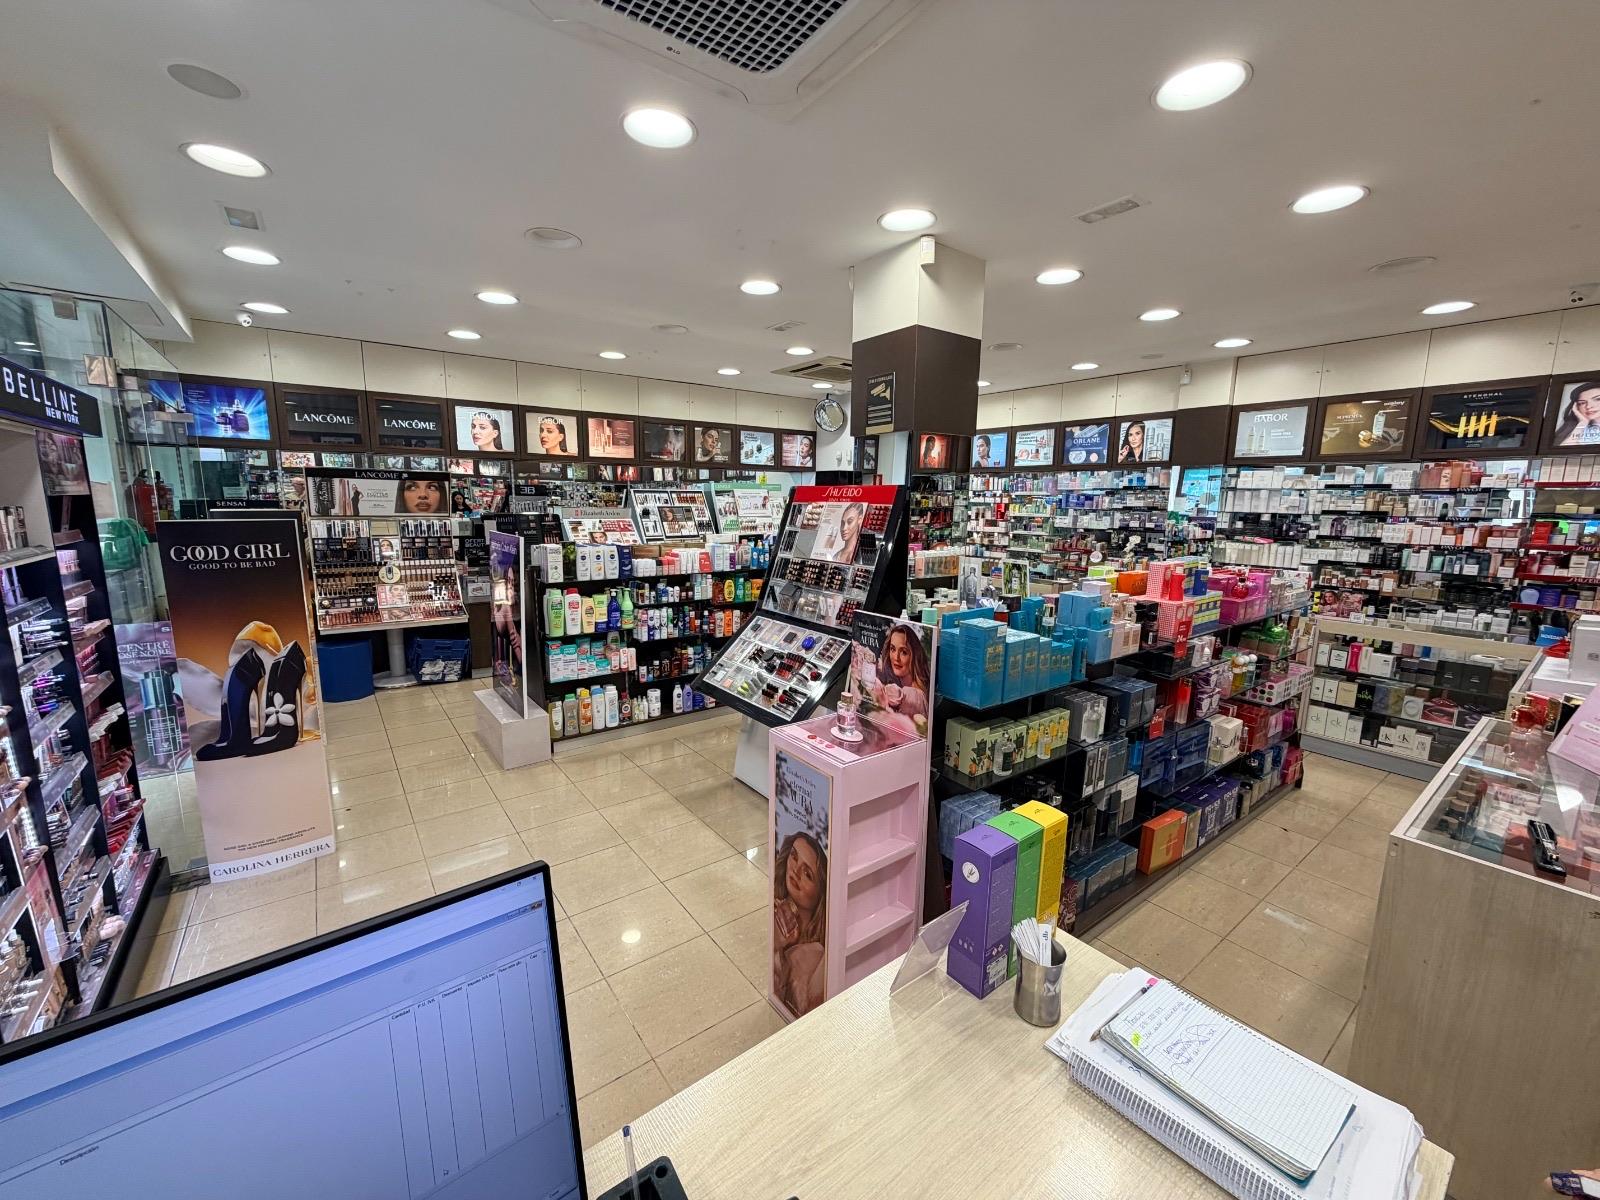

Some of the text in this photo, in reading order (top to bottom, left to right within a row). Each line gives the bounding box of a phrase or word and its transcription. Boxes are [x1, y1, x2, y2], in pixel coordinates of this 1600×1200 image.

[3, 367, 79, 415] BELLINE
[46, 406, 80, 425] NEW YORK
[294, 412, 354, 425] LANCÔME
[1254, 413, 1288, 423] BABOR
[384, 418, 437, 431] LANCÔME
[1073, 437, 1101, 445] ORLANE
[821, 487, 863, 497] SHISEIDO
[581, 509, 605, 517] Elizabeth
[170, 543, 291, 562] GOOD GIRL
[188, 562, 220, 570] GOOD
[256, 560, 276, 568] BAD
[117, 640, 171, 653] CENTRÉ
[860, 635, 880, 648] AURA
[213, 859, 272, 877] CAROLINA
[275, 841, 331, 864] HERRERA
